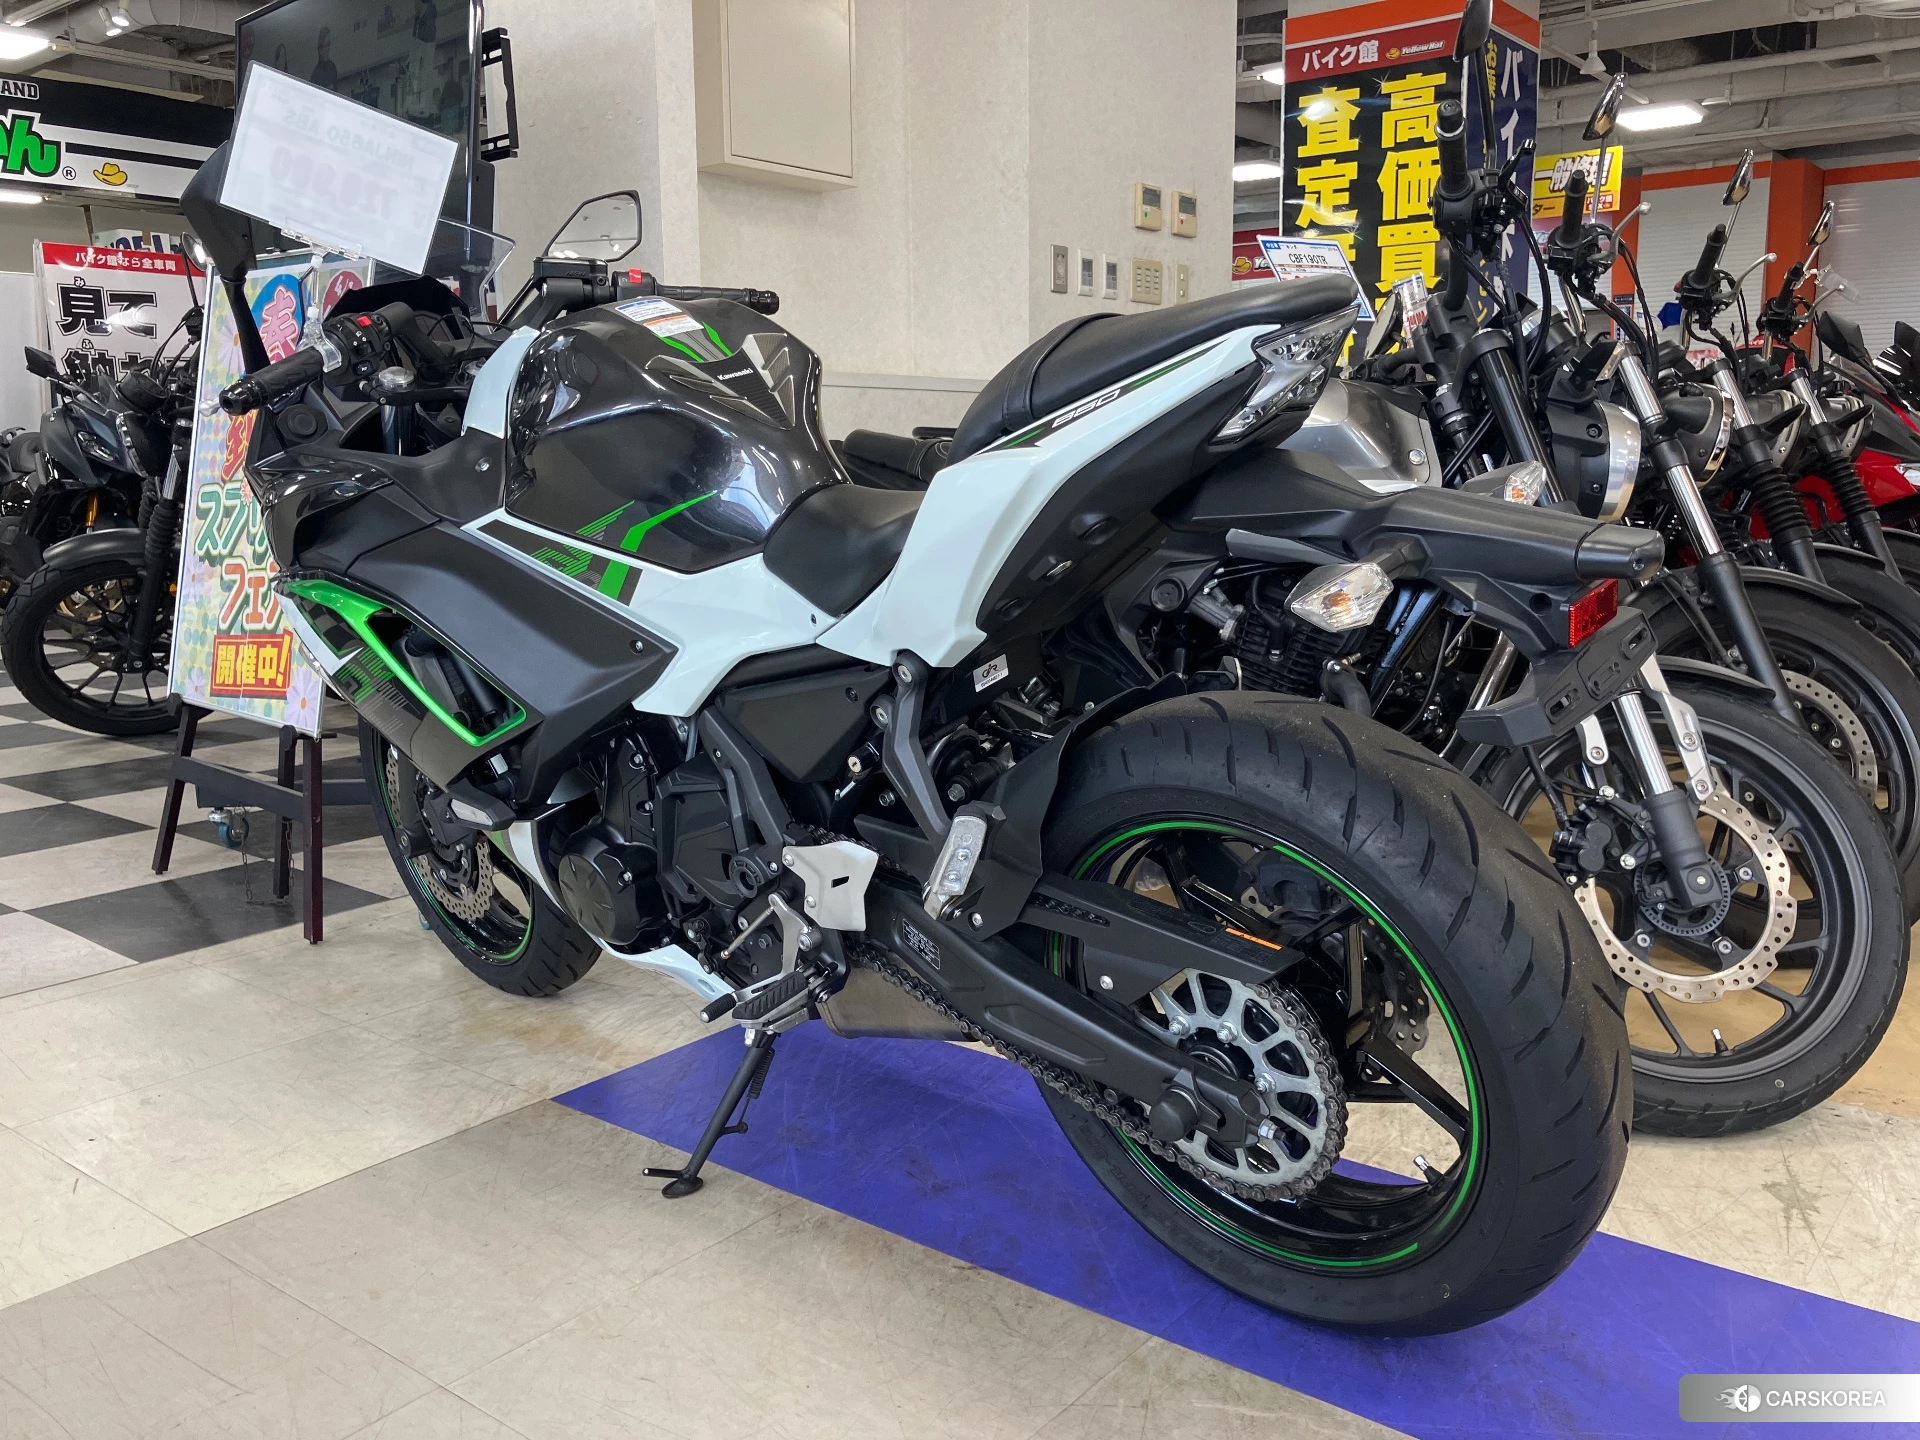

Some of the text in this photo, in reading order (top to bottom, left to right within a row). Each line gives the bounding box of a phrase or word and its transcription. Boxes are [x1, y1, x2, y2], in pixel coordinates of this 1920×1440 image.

[1301, 40, 1379, 73] バイク館
[1375, 72, 1448, 312] 高価買
[75, 251, 177, 272] バイク館なら全車両
[1289, 253, 1329, 265] CBF190TR
[56, 282, 158, 339] 見て
[717, 368, 754, 381] Kawasaki
